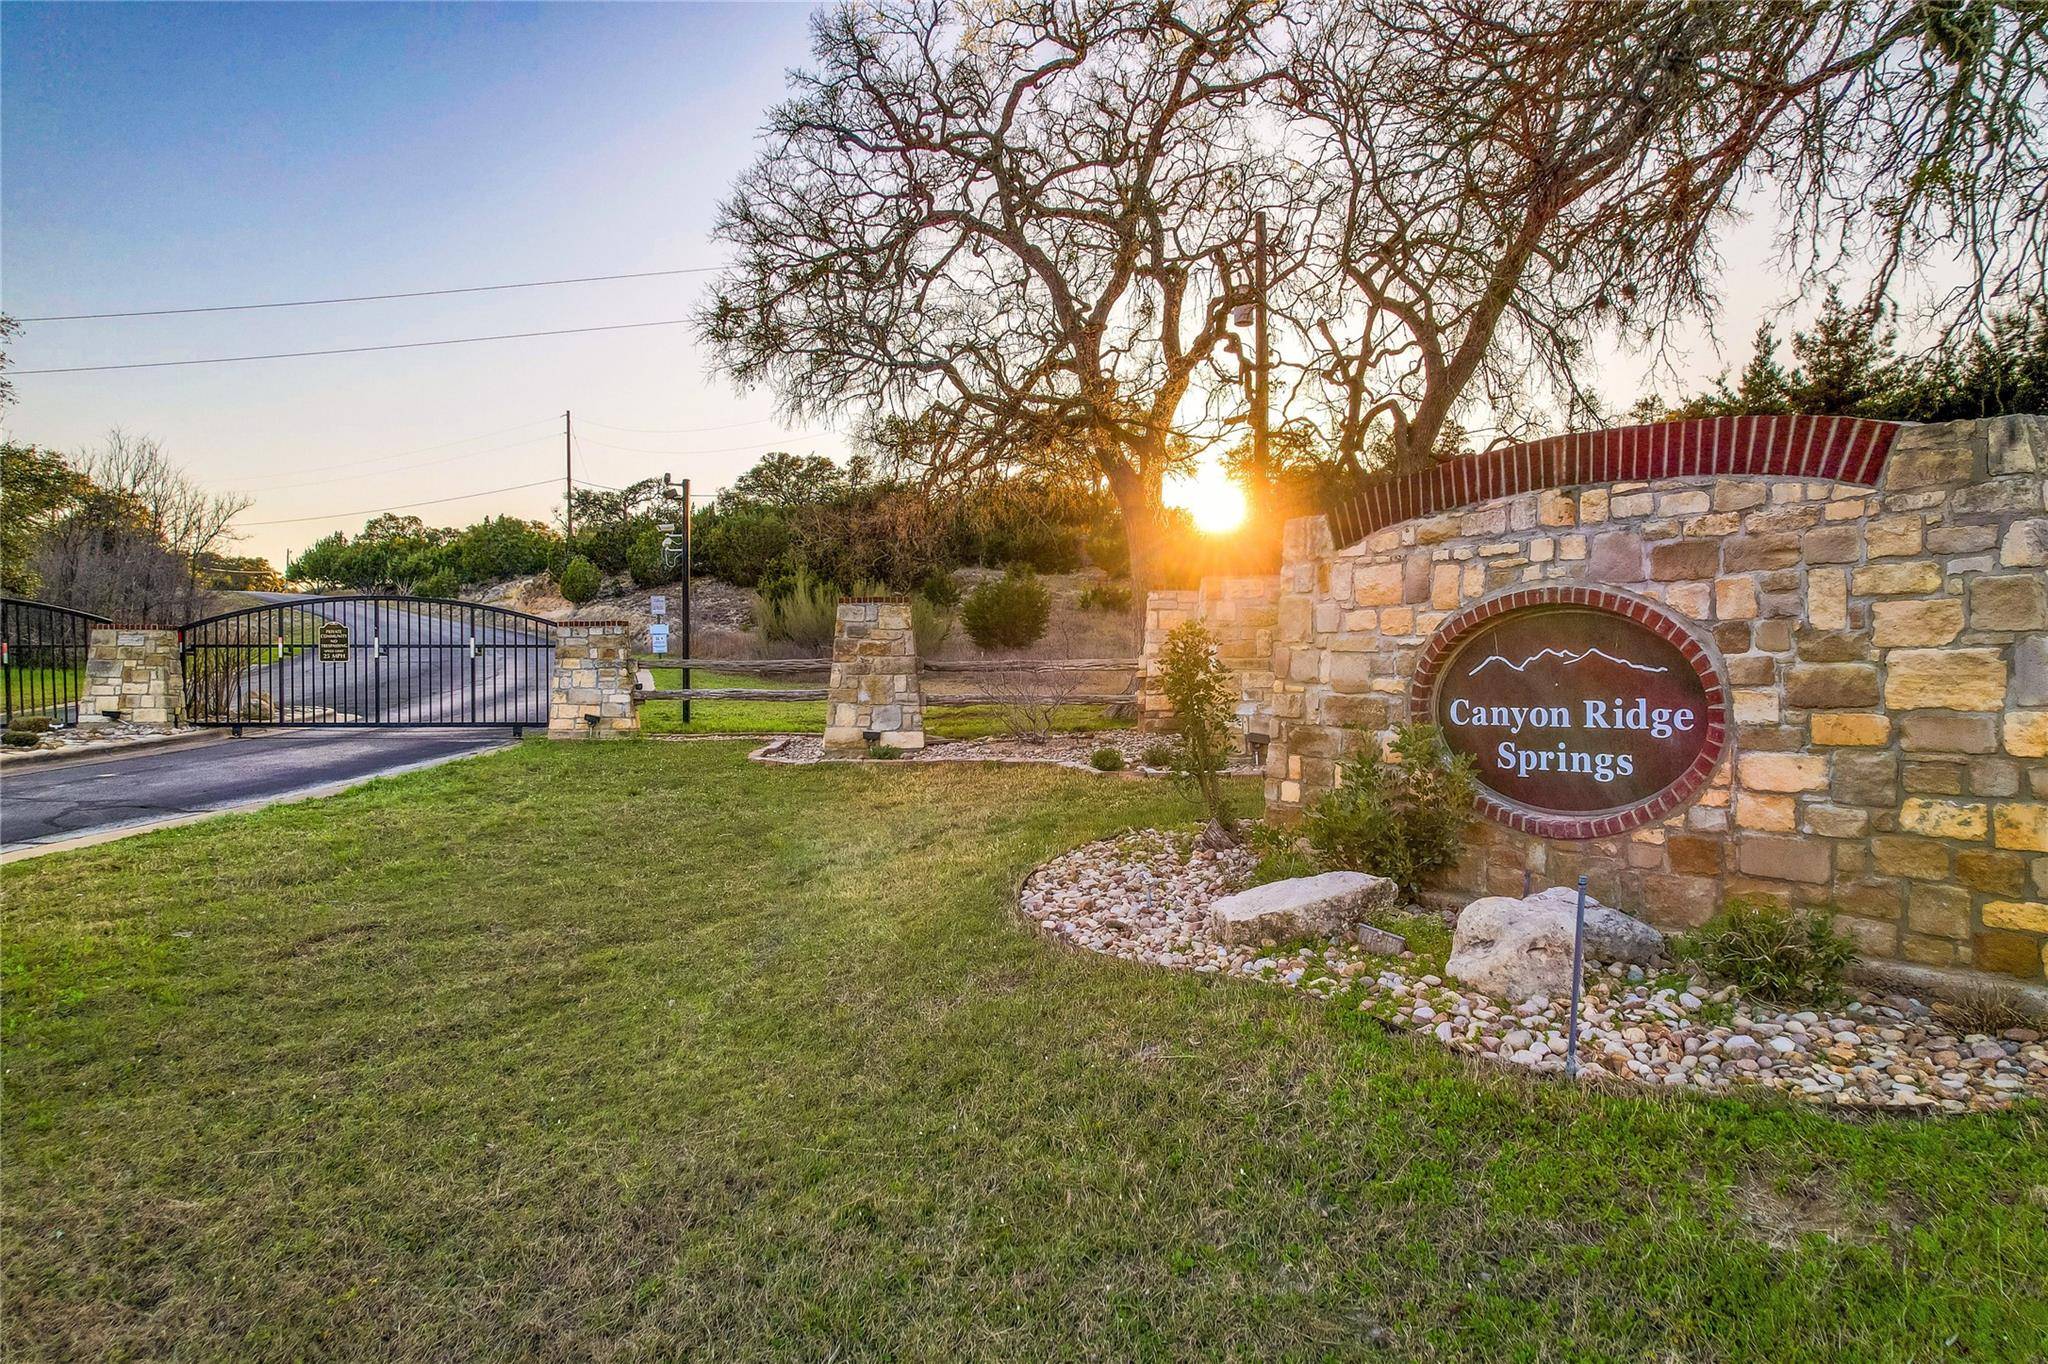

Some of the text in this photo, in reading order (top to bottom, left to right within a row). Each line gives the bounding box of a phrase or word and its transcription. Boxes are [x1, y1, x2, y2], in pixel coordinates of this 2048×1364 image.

[1450, 698, 1694, 738] Canyon Ridge
[1498, 741, 1634, 782] Springs
